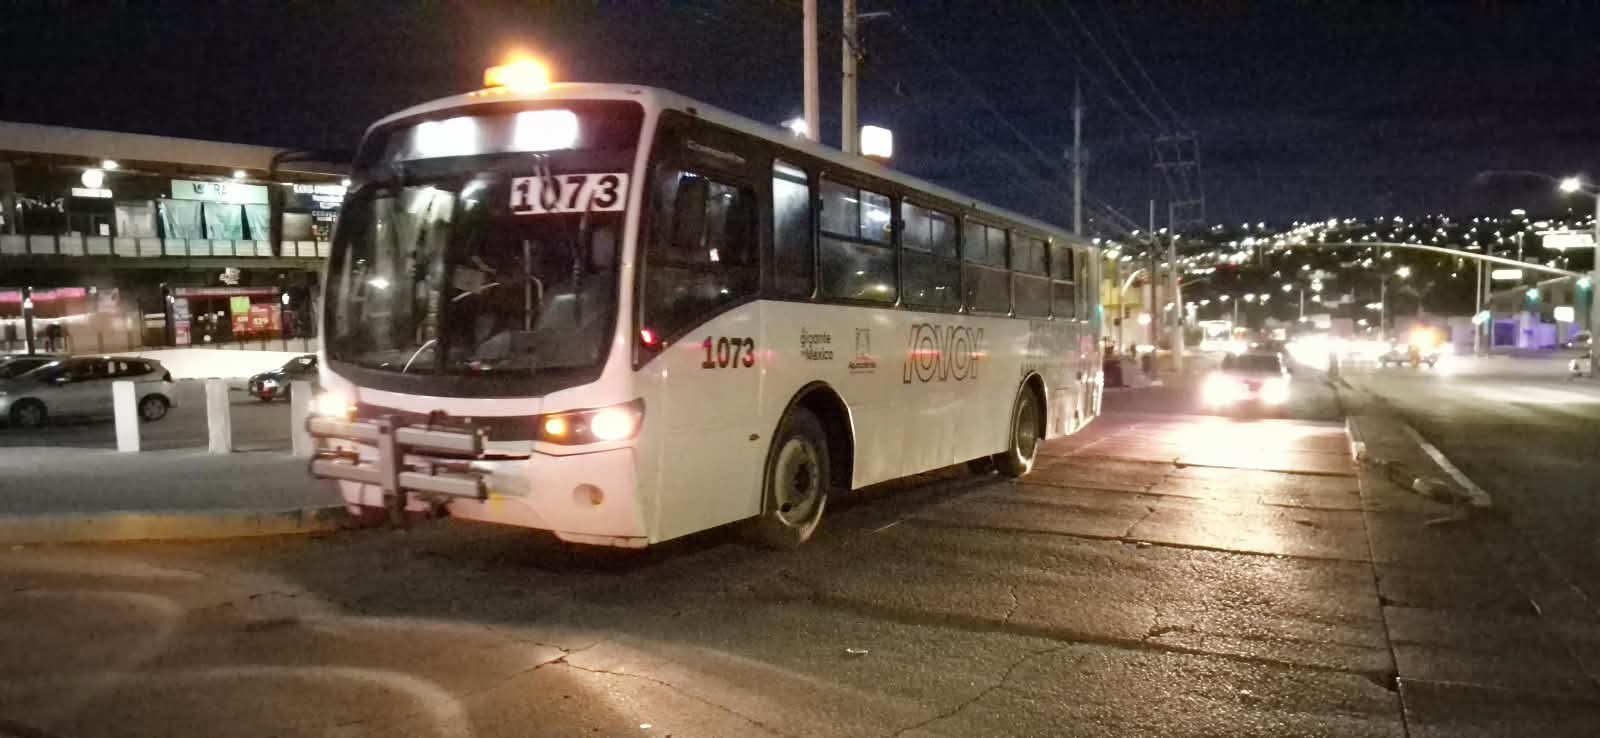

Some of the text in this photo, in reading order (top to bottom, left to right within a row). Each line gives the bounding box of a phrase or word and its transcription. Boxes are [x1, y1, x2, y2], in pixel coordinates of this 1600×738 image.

[513, 174, 620, 213] 1073
[701, 336, 754, 369] 1073
[799, 332, 831, 348] gigante
